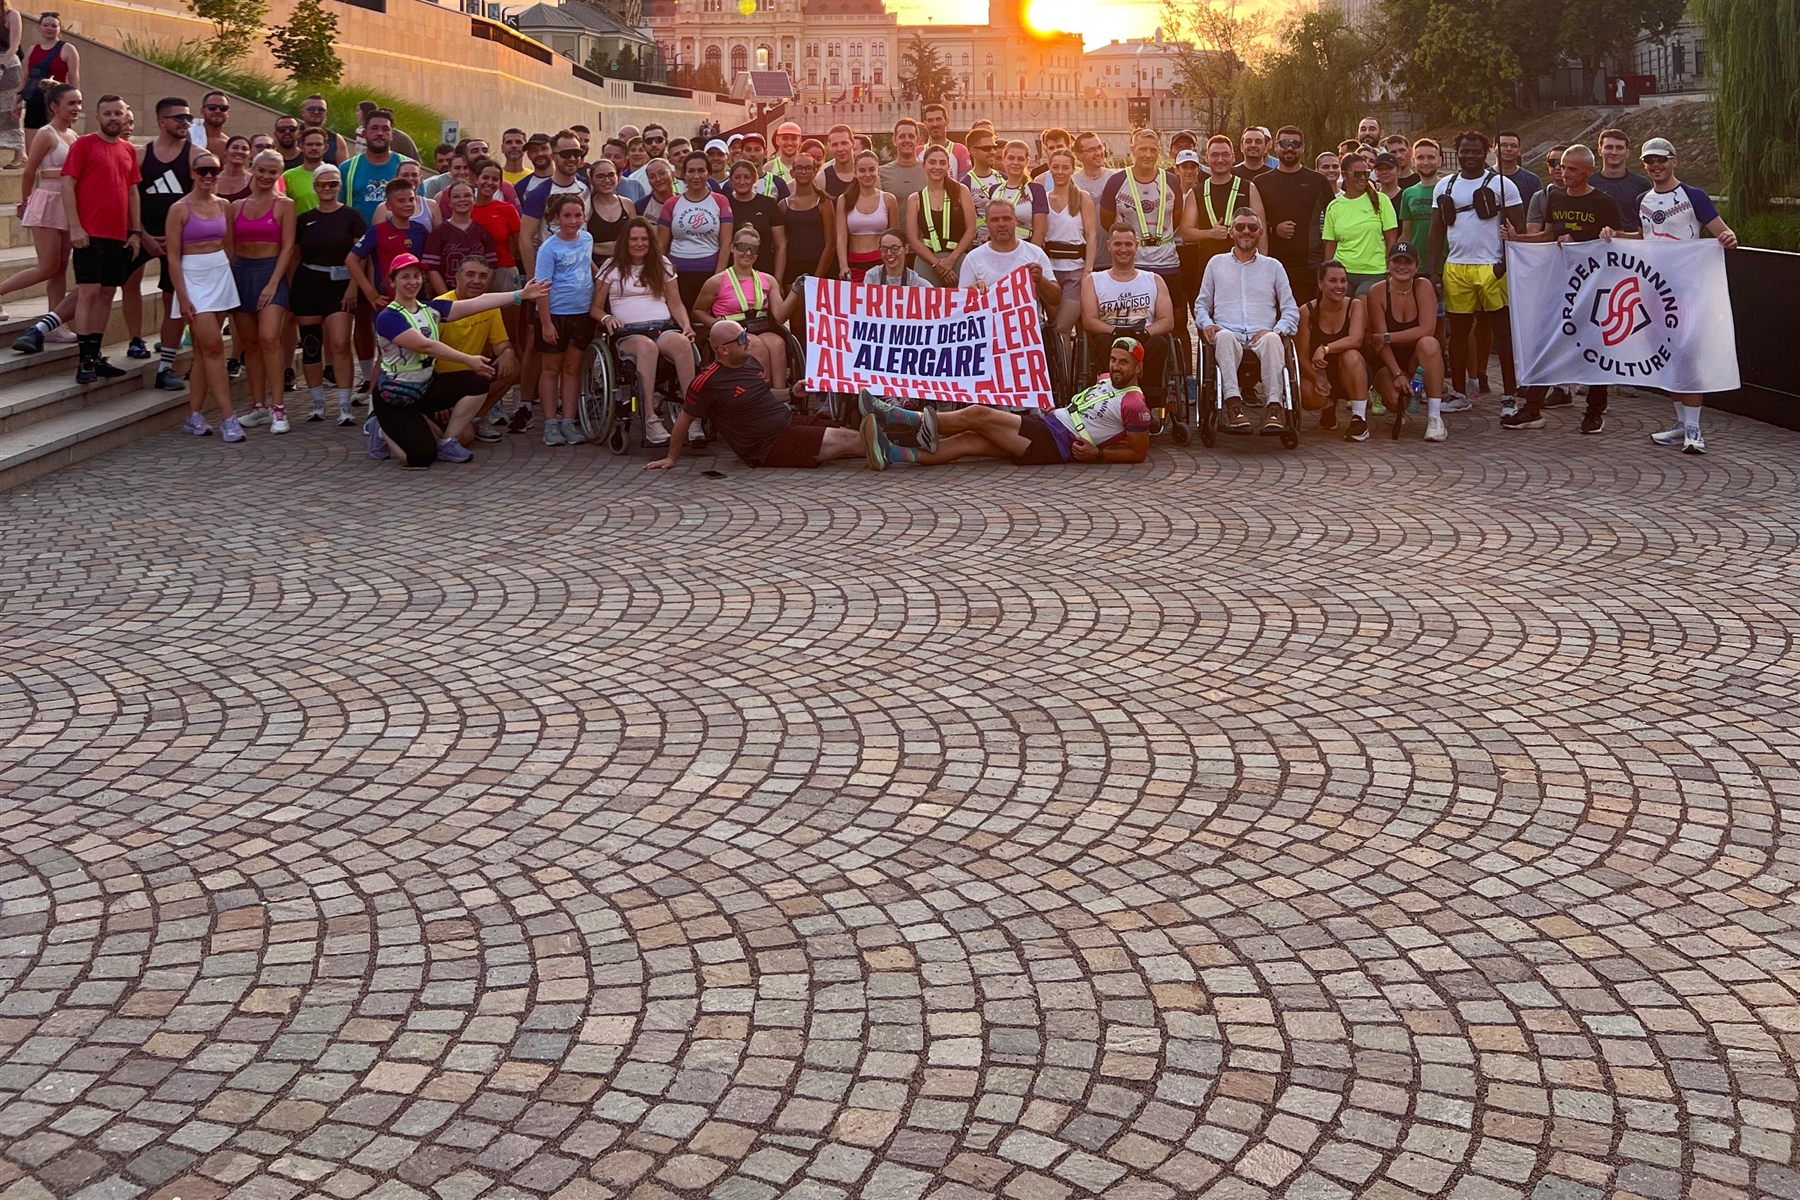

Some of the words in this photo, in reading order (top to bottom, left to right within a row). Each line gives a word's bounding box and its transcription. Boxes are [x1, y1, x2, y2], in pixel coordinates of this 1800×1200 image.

[1561, 256, 1601, 336] ORADEA
[1606, 251, 1679, 329] RUNNING
[852, 320, 886, 344] MAI
[889, 324, 934, 346] MULT
[937, 315, 986, 345] DECÂT
[853, 342, 987, 377] ALERGARE
[1583, 344, 1671, 377] CULTURE
